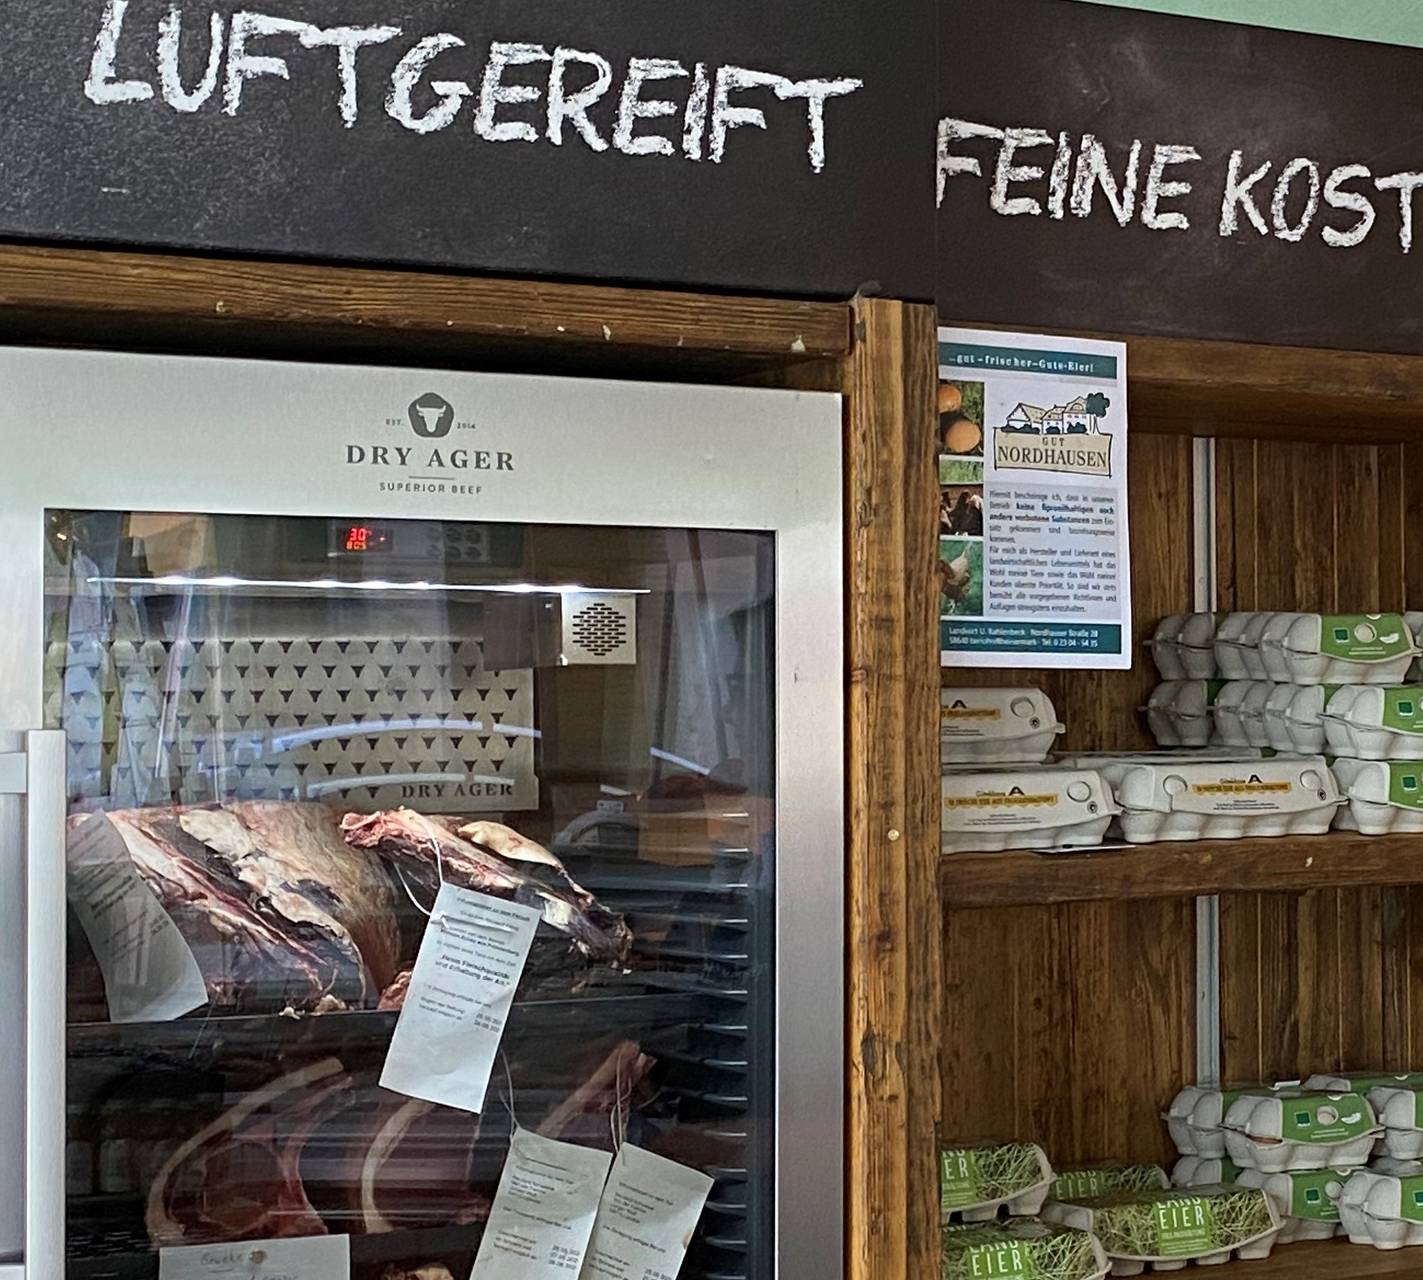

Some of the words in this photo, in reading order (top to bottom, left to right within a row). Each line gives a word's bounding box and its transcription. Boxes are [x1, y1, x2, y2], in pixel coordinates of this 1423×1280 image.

[83, 0, 864, 174] LUFTGEREIFT
[936, 116, 1202, 231] FEINE
[1042, 437, 1065, 447] GUT
[346, 444, 413, 467] DRY
[426, 447, 515, 471] AGER
[998, 446, 1108, 468] NORDHAUSEN
[379, 481, 445, 493] SUPERIOR
[451, 484, 483, 495] BEEF
[401, 784, 446, 798] DRY
[454, 783, 513, 797] AGER
[1056, 1173, 1100, 1200] EIER
[1159, 1205, 1205, 1230] EIER
[971, 1250, 1023, 1277] EIER
